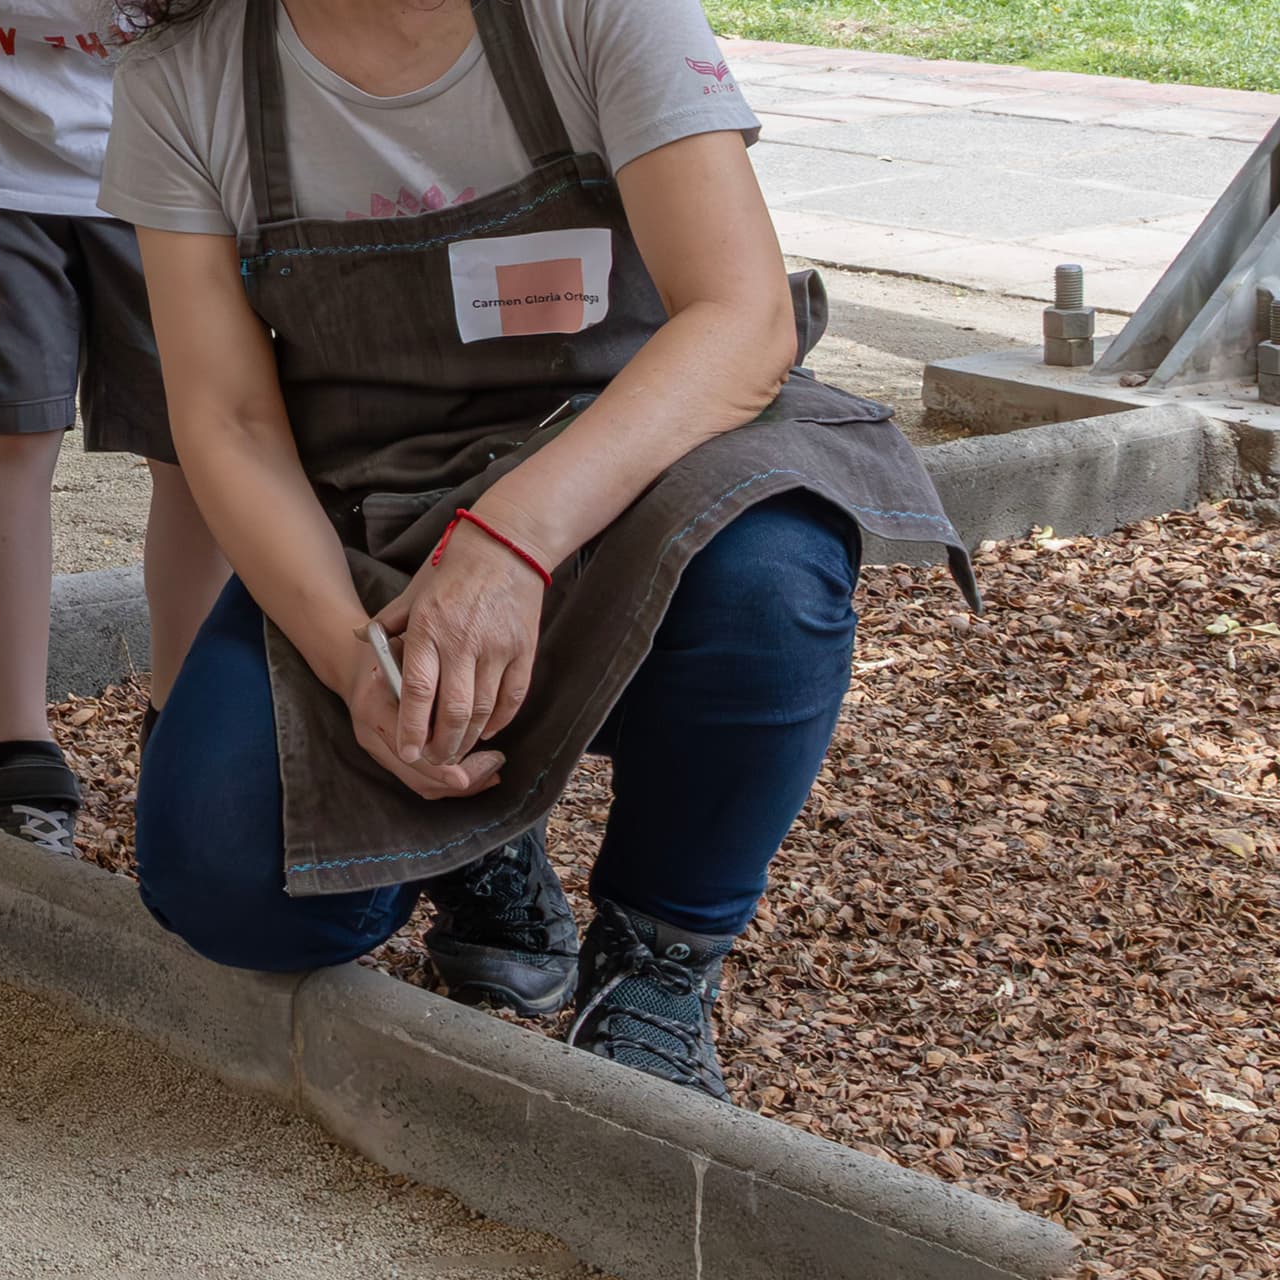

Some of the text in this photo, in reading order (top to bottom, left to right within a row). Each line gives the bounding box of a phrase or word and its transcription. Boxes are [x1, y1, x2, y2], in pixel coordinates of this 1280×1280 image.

[472, 291, 600, 309] Carmen Gloria Ortega
